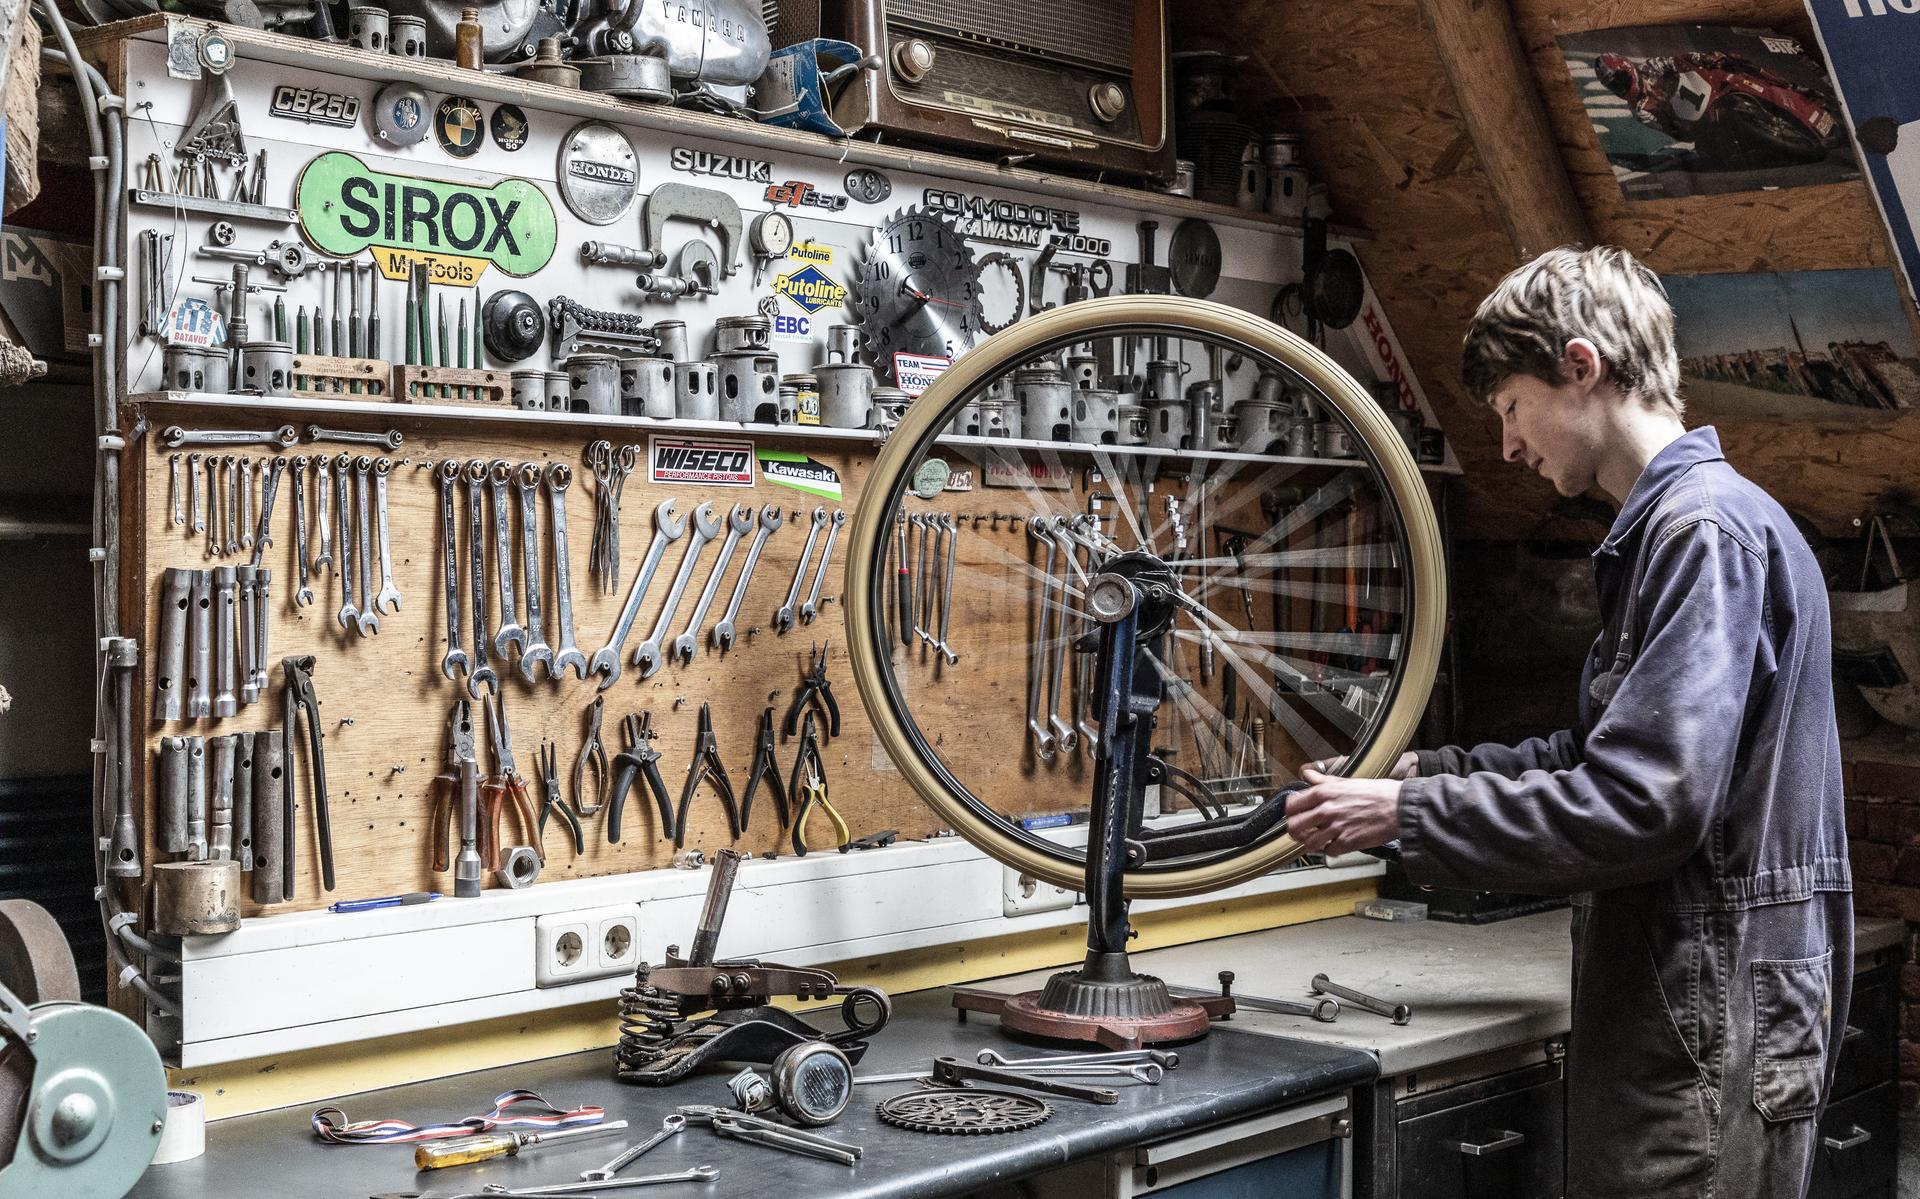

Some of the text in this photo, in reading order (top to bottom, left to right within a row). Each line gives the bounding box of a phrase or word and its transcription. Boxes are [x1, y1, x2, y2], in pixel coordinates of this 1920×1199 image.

[663, 1, 745, 42] YAMAHA
[275, 87, 360, 121] CB250
[1679, 86, 1705, 112] 1
[441, 98, 482, 122] BMW
[498, 137, 524, 145] HONDA
[505, 142, 518, 150] 50
[570, 161, 635, 184] HONDA
[673, 147, 775, 183] SUZUKI
[340, 176, 521, 256] SIROX
[924, 188, 1080, 233] COMMODORE
[907, 222, 924, 241] 12
[935, 230, 944, 248] 1
[954, 216, 1043, 247] KAWASAKI
[888, 234, 904, 254] 11
[791, 247, 830, 261] Putoline
[954, 251, 963, 270] 2
[424, 257, 473, 281] Tools
[874, 261, 889, 281] 10
[775, 274, 845, 301] Putoline
[963, 282, 972, 301] 3
[805, 297, 844, 308] LUBRICANTS
[870, 295, 880, 314] 9
[775, 316, 810, 335] EBC
[959, 314, 968, 333] 4
[174, 332, 208, 345] BATAVUS
[881, 326, 891, 346] 8
[945, 340, 954, 359] 5
[897, 359, 920, 369] TEAM
[901, 374, 935, 387] HON
[656, 448, 749, 473] WISECO
[664, 472, 739, 482] PERFORMANCE PISTONS
[768, 461, 836, 482] Kawasaki
